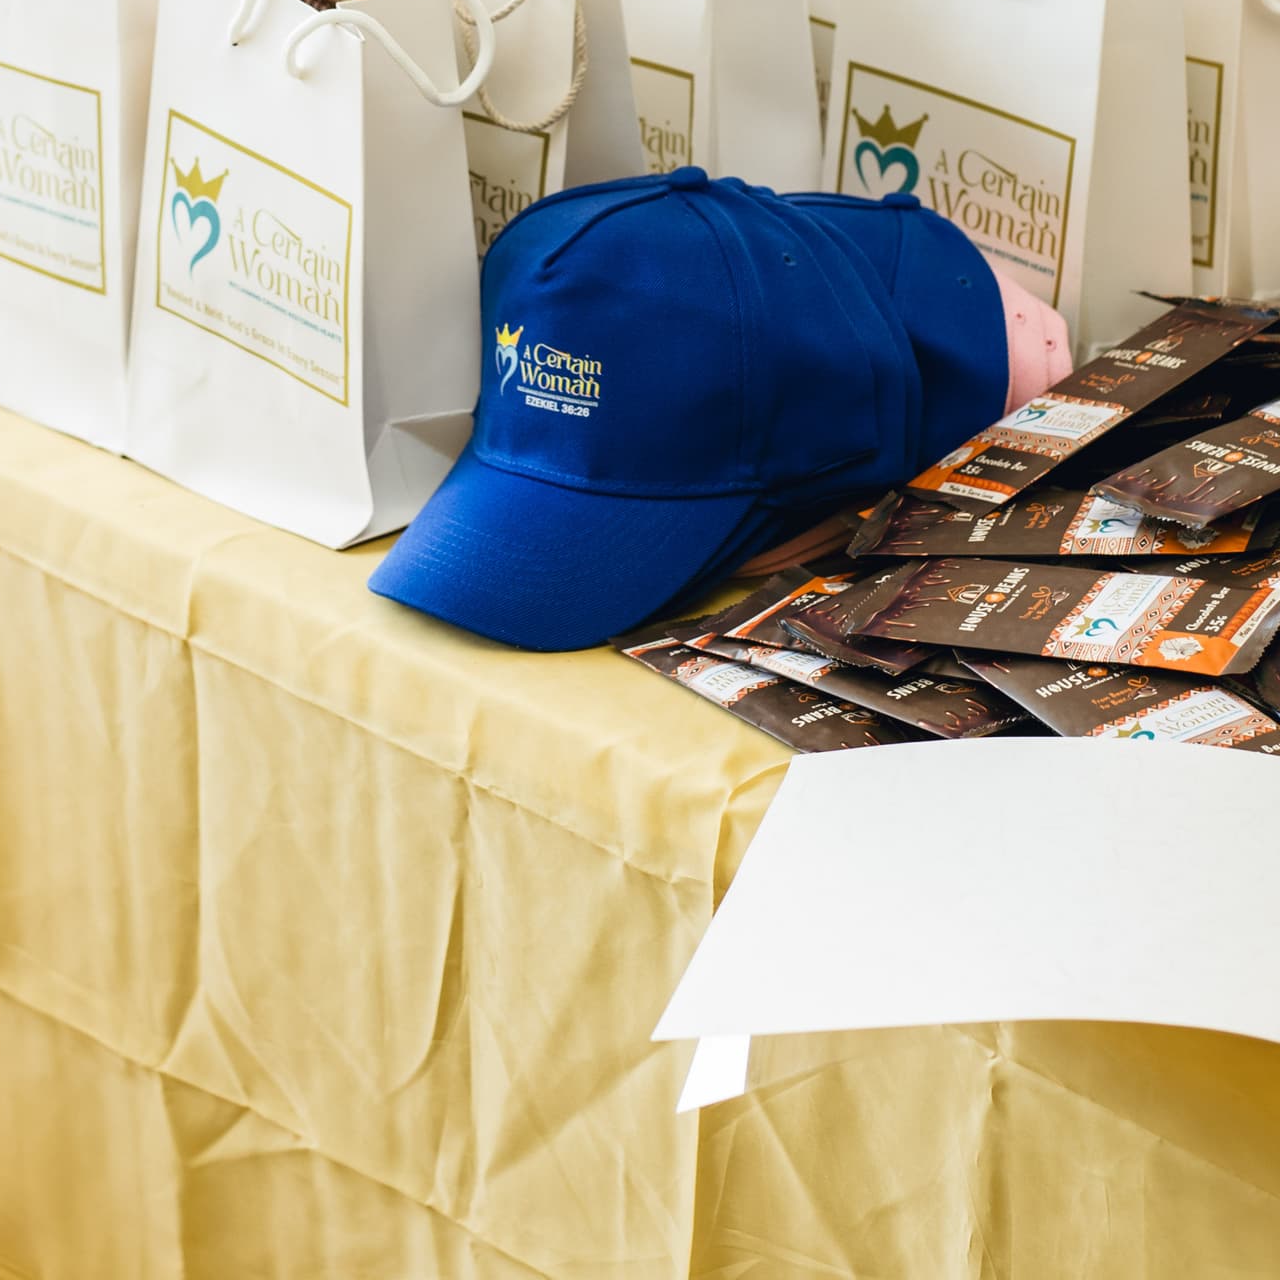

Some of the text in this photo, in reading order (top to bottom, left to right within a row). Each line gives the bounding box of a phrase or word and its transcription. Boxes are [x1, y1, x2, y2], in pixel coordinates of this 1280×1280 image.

[935, 149, 1061, 224] A Certain
[928, 176, 1058, 261] Woman
[232, 206, 342, 292] A Certain
[228, 233, 342, 328] Woman
[523, 343, 602, 378] A Certain
[1146, 354, 1187, 369] BEANS
[520, 360, 601, 400] Woman
[525, 395, 560, 412] EZEKIEL
[561, 403, 590, 418] 36:26
[1184, 439, 1226, 461] BEANS
[958, 567, 1031, 632] HOUSE BEANS
[1185, 586, 1232, 631] Chocolate Bar
[886, 678, 934, 701] BEANS
[1035, 667, 1091, 698] HOUSE
[791, 705, 842, 728] BEANS
[1158, 702, 1237, 736] Woman
